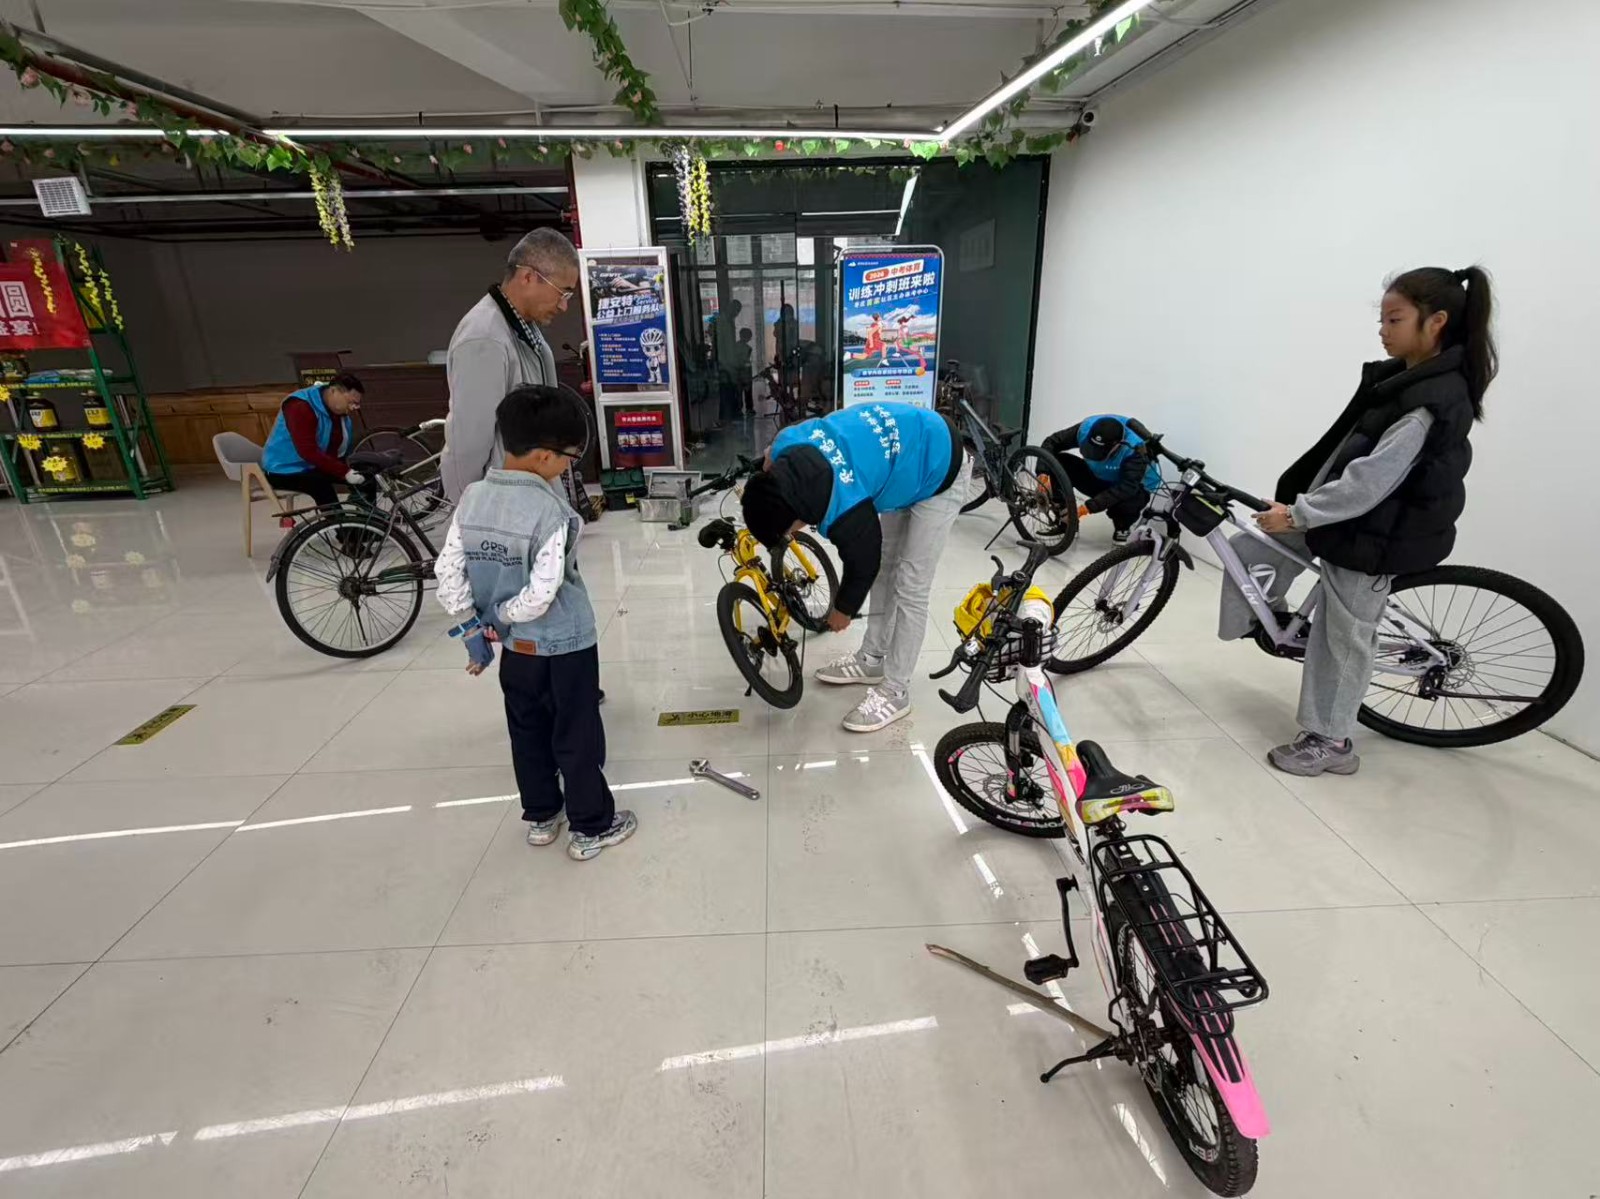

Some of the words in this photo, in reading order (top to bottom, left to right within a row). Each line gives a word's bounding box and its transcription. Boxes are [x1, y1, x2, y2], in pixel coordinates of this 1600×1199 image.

[0, 281, 34, 318] 圆
[848, 271, 936, 301] 训练冲刺班来啦
